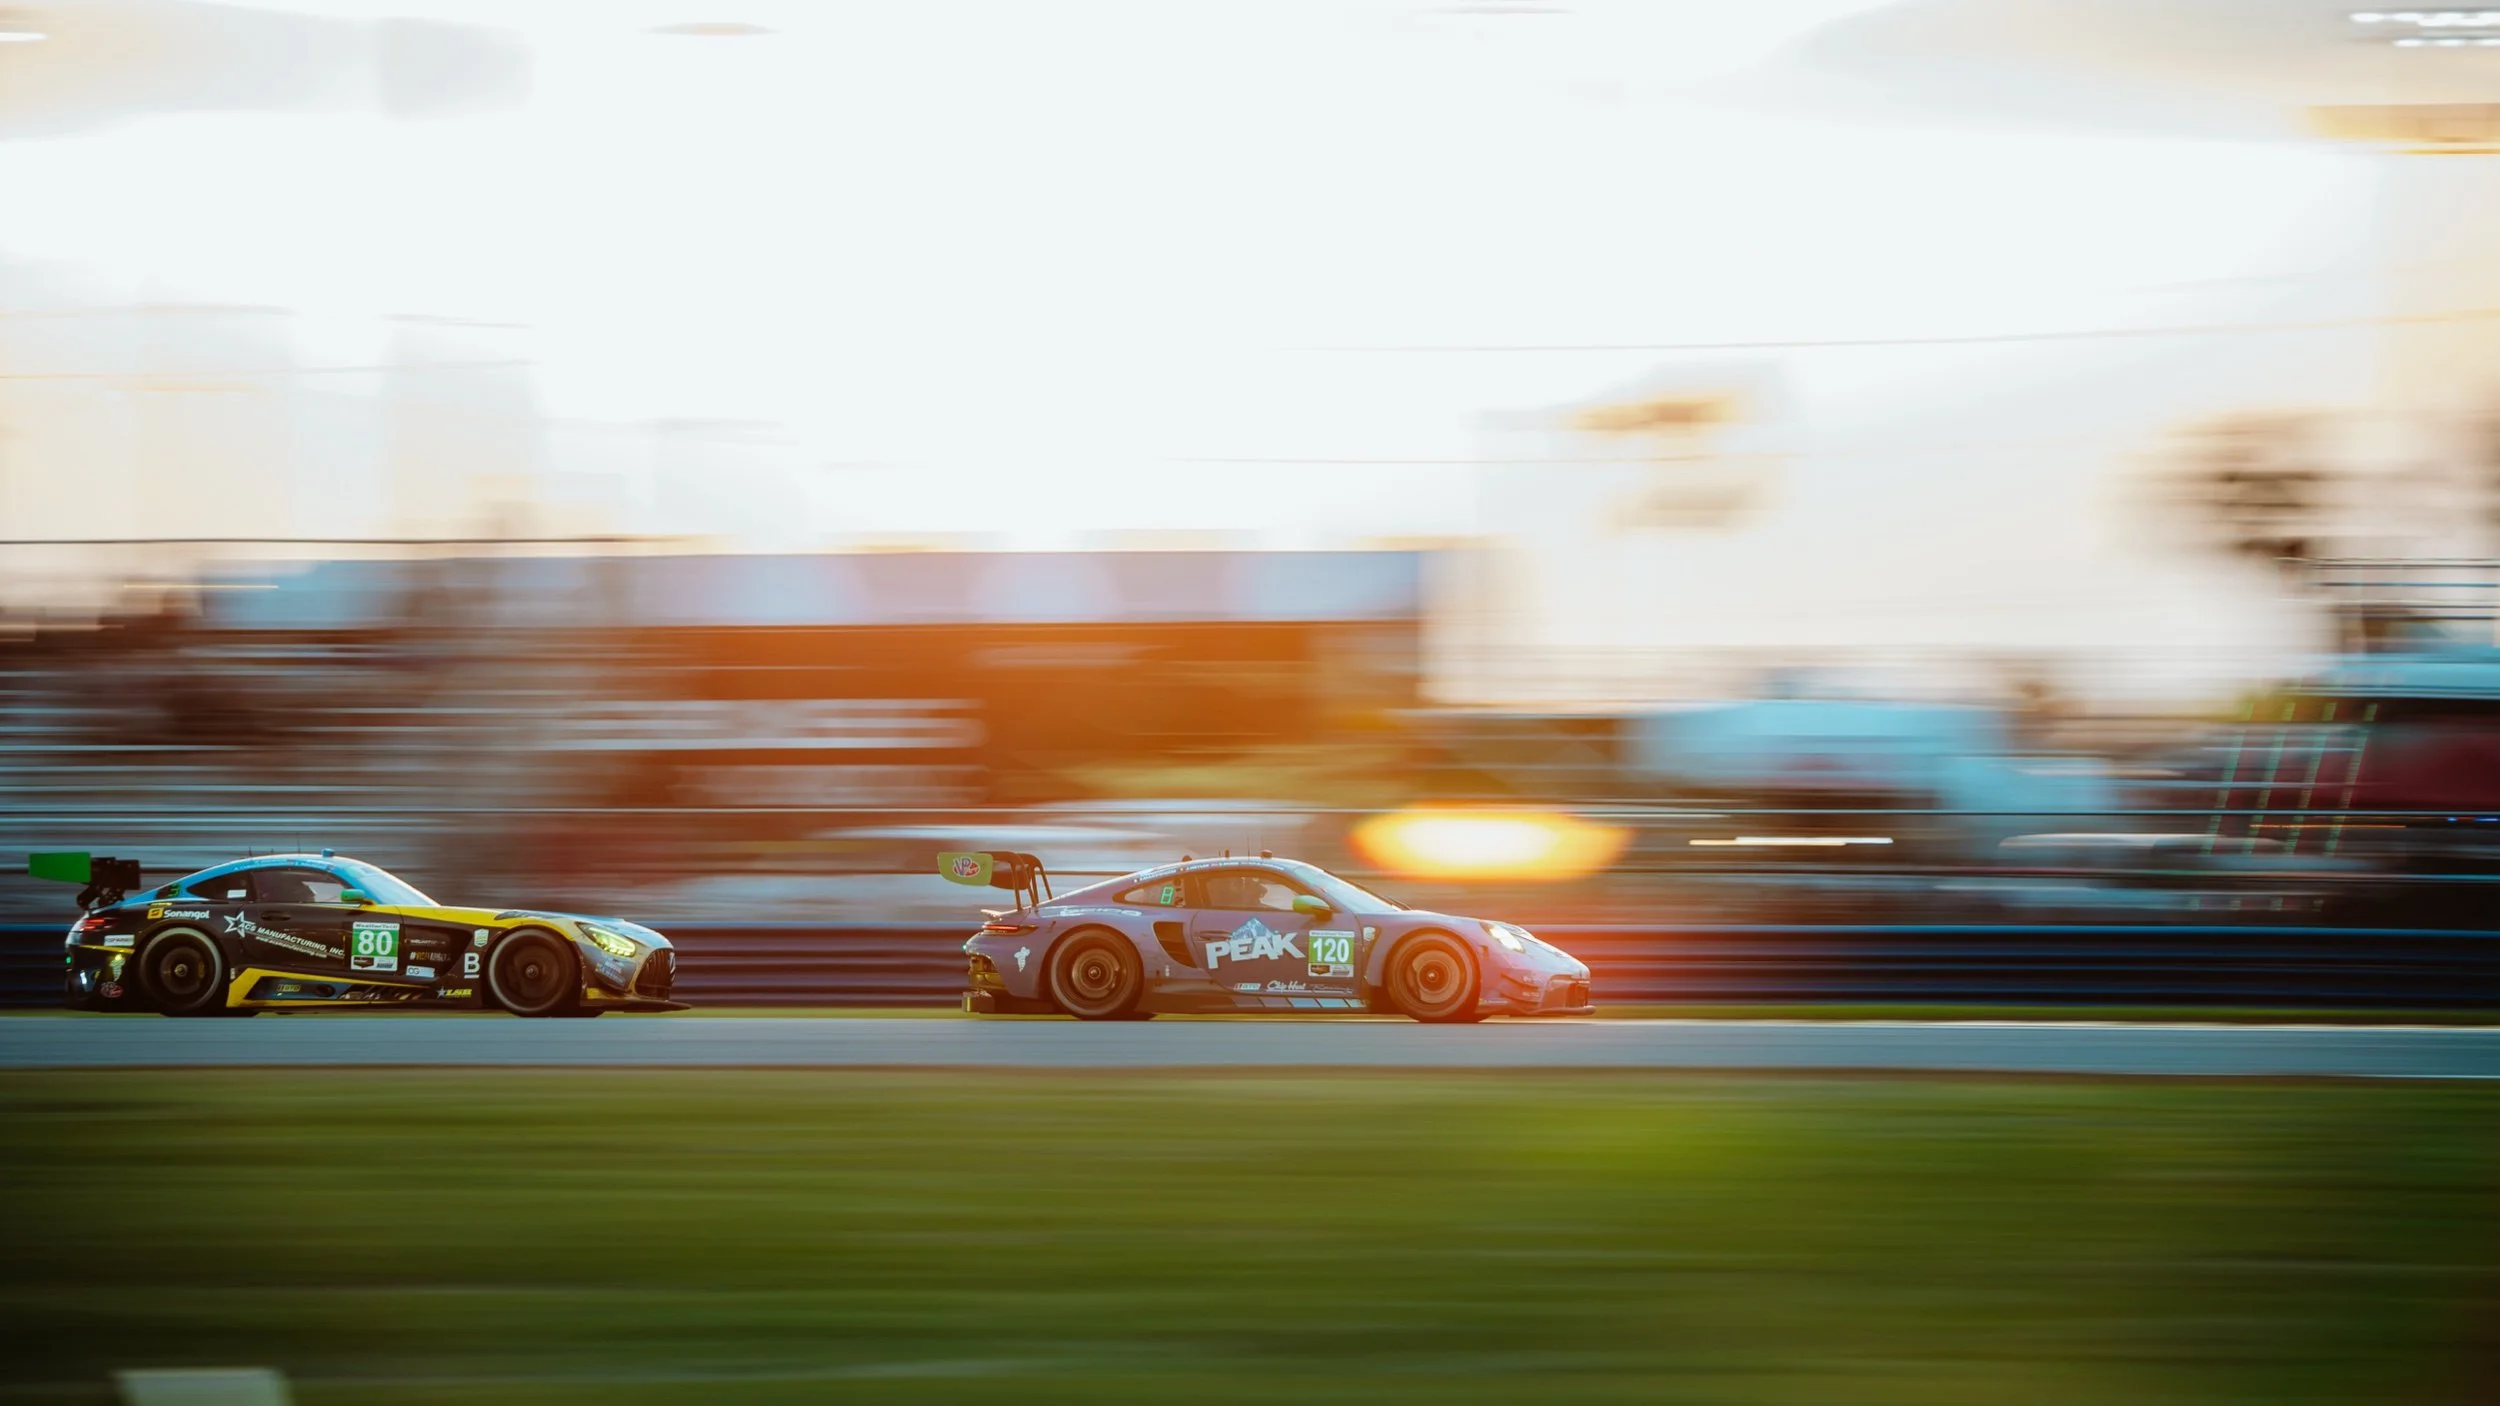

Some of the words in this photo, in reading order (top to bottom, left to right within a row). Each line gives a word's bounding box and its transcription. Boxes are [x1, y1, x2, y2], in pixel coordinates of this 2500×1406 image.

[163, 909, 210, 920] Sonangol
[357, 929, 393, 956] 80
[1205, 931, 1306, 970] PEAK
[1312, 937, 1350, 963] 120
[464, 952, 481, 973] B
